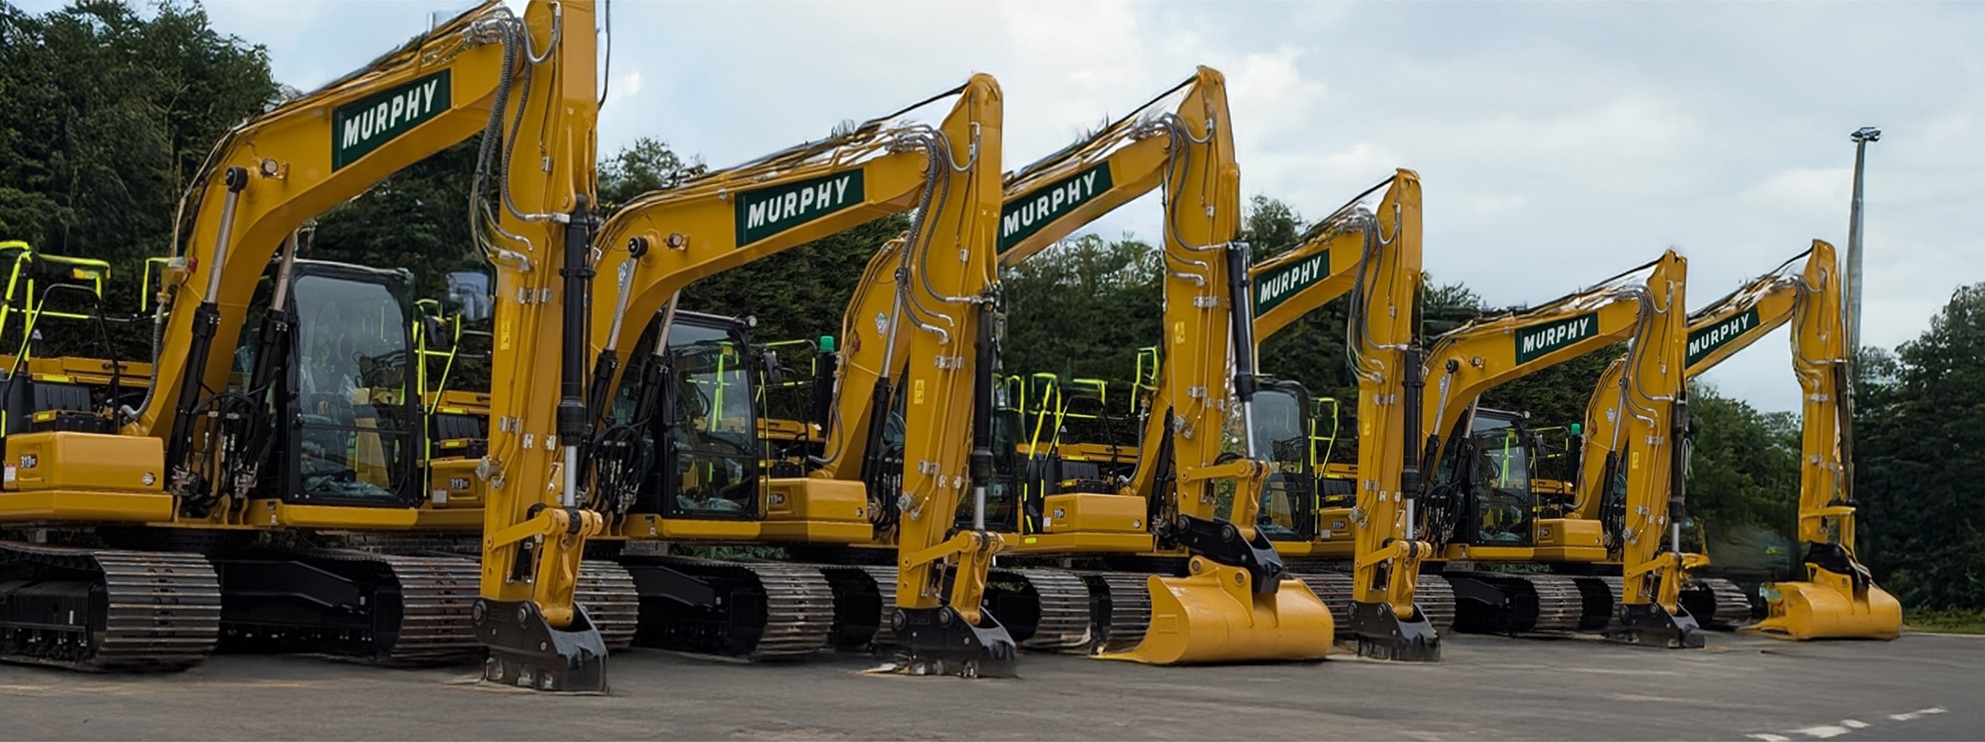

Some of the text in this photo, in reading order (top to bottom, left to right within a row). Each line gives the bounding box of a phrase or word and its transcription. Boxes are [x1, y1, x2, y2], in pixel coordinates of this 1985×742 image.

[342, 79, 438, 149] MURPHY
[747, 176, 850, 229] MURPHY
[1002, 170, 1096, 237] MURPHY
[1260, 256, 1321, 304] MURPHY
[1523, 317, 1589, 354] MURPHY
[1689, 313, 1749, 357] MURPHY
